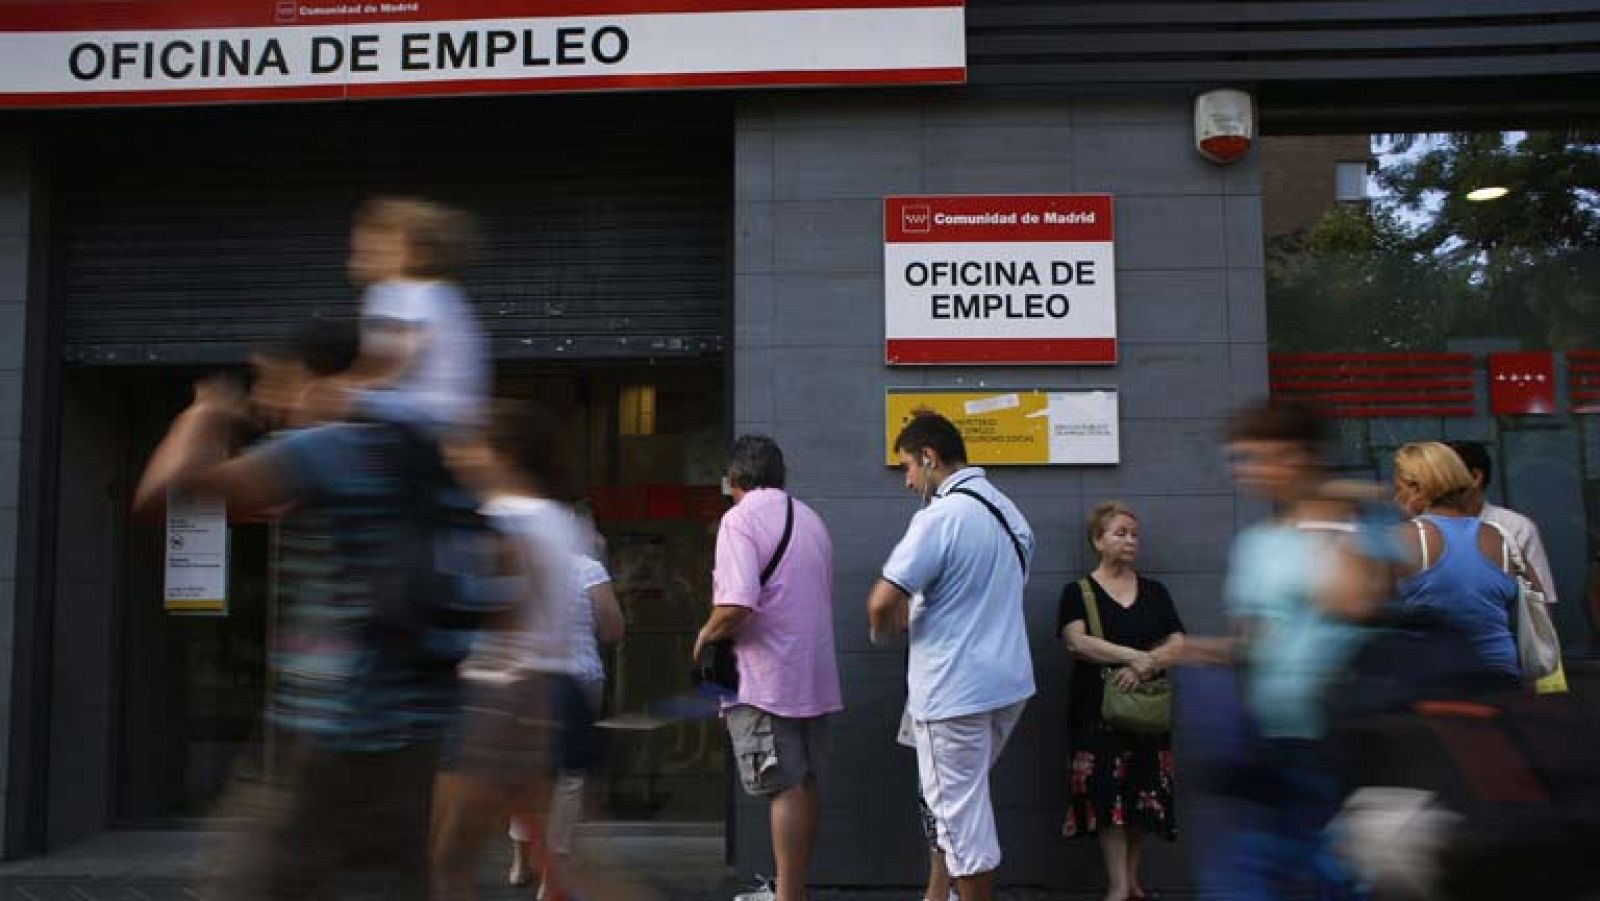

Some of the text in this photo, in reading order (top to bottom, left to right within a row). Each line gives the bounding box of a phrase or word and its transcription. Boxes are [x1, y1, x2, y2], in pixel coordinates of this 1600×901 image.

[299, 3, 418, 15] Comunidad de Madrid
[68, 26, 629, 81] OFICINA DE EMPLEO
[934, 211, 1096, 225] Comunidad de Madrid
[904, 260, 1096, 287] OFICINA DE
[930, 293, 1070, 319] EMPLEO
